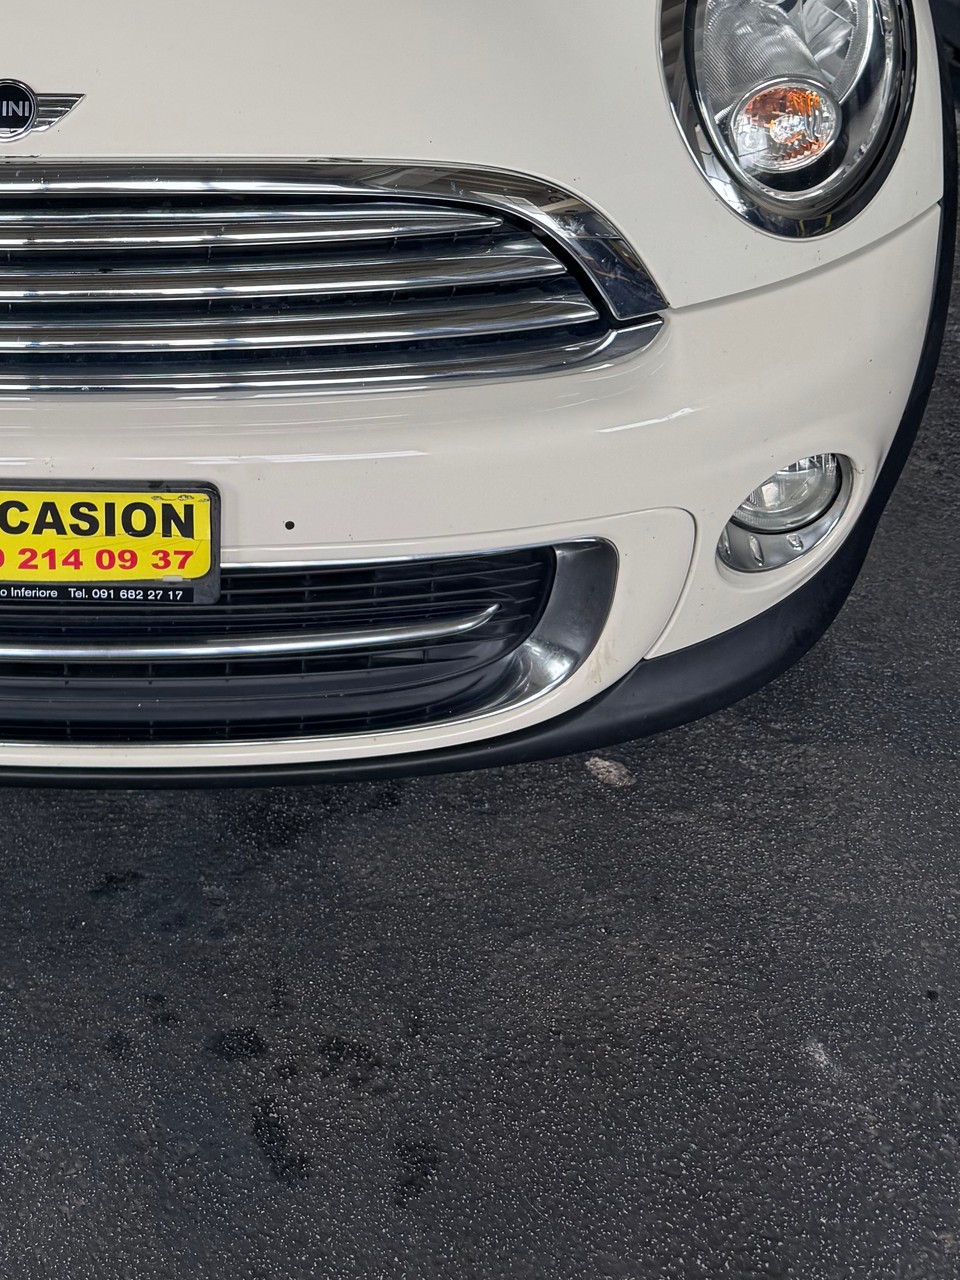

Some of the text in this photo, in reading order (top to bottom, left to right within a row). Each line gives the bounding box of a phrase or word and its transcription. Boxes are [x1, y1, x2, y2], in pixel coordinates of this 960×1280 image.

[17, 547, 83, 570] 214
[96, 549, 138, 570] 09
[151, 550, 194, 570] 37
[11, 586, 58, 598] Inferiore
[68, 588, 88, 599] Tel.
[92, 588, 114, 599] 091
[120, 589, 144, 600] 682
[147, 590, 163, 600] 27
[168, 590, 183, 600] 17
